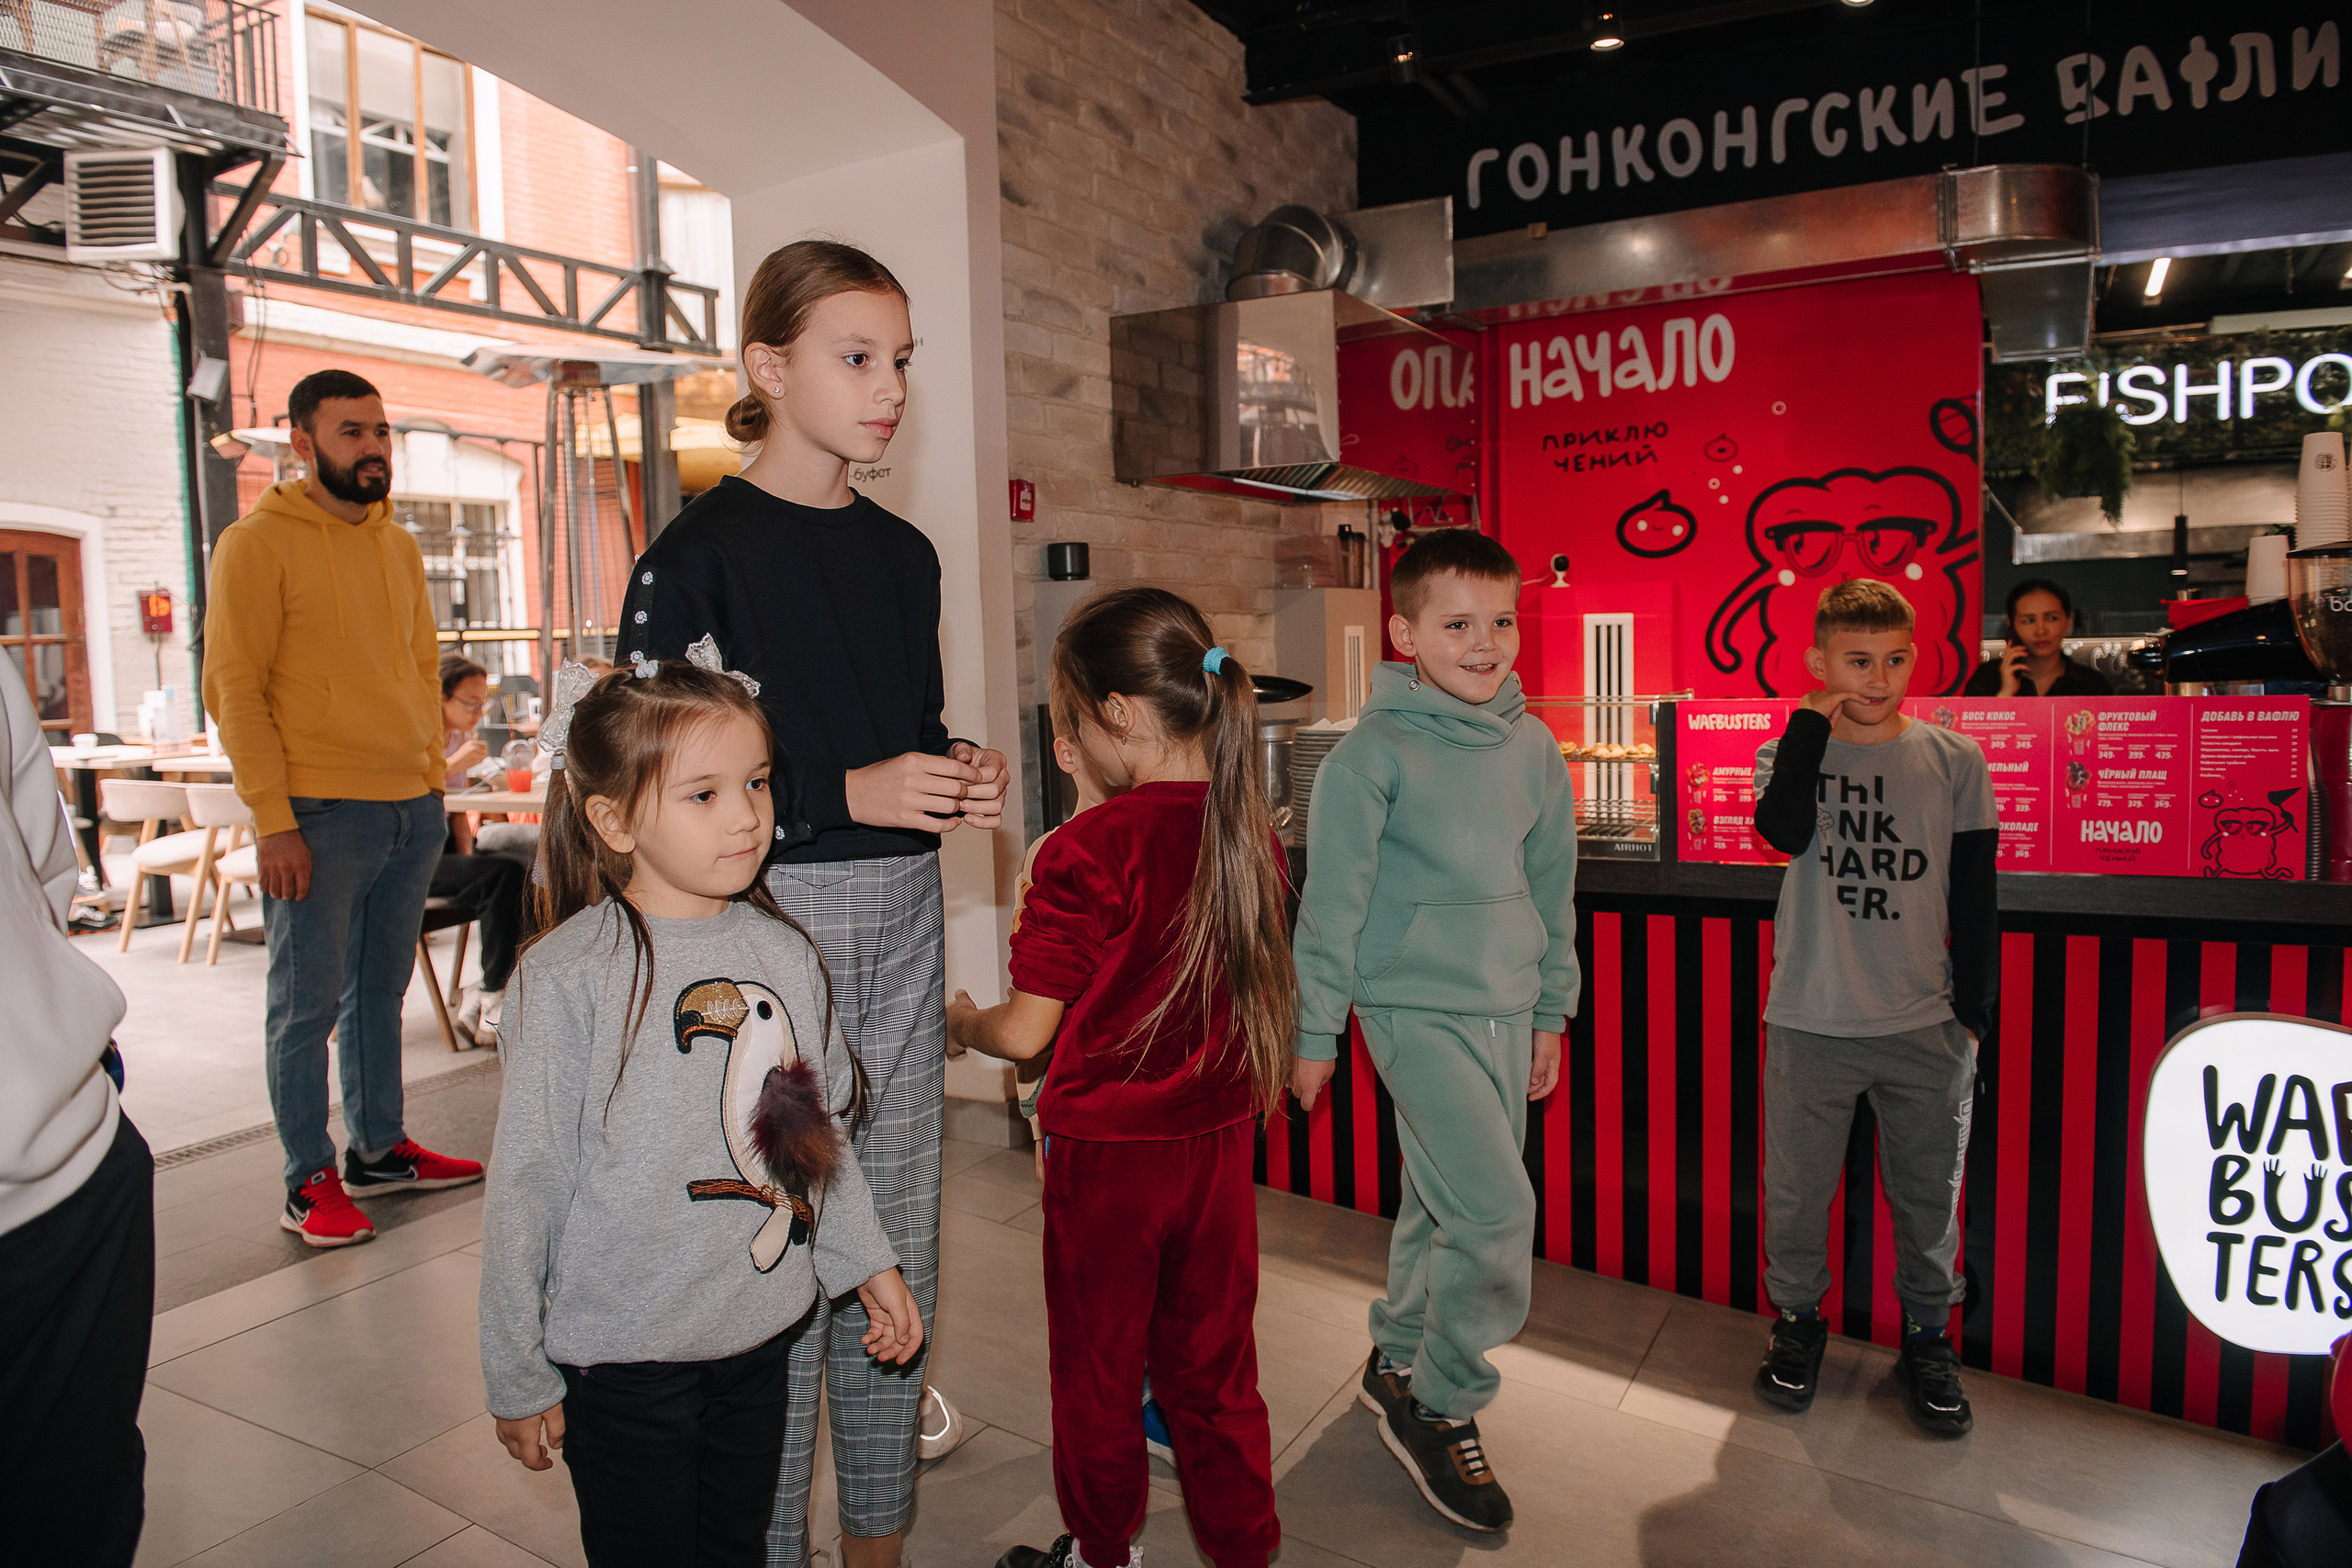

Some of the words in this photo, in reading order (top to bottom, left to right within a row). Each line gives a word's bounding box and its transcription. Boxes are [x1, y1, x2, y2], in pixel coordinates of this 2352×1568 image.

[1467, 63, 2025, 209] ГОНКОНГСКИЕ
[2056, 21, 2340, 125] ВАФЛИ
[1543, 421, 1668, 451] ПРИКЛЮ
[1554, 445, 1657, 472] ЧЕНИЙ
[1687, 713, 1772, 731] WAFBUSTERS
[1962, 711, 1985, 721] БОСС
[1986, 711, 2017, 721] КОКОС
[2098, 710, 2157, 722] ФРУКТОВЫЙ
[2200, 711, 2245, 723] ДОБАВЬ
[2246, 711, 2256, 722] В
[2256, 711, 2301, 722] ВАФЛЮ
[2098, 722, 2130, 732] ФЛЕКС
[2098, 768, 2138, 780] ЧЁРНЫЙ
[2138, 770, 2167, 781] ПЛАЩ
[1613, 842, 1654, 852] AIRHOT
